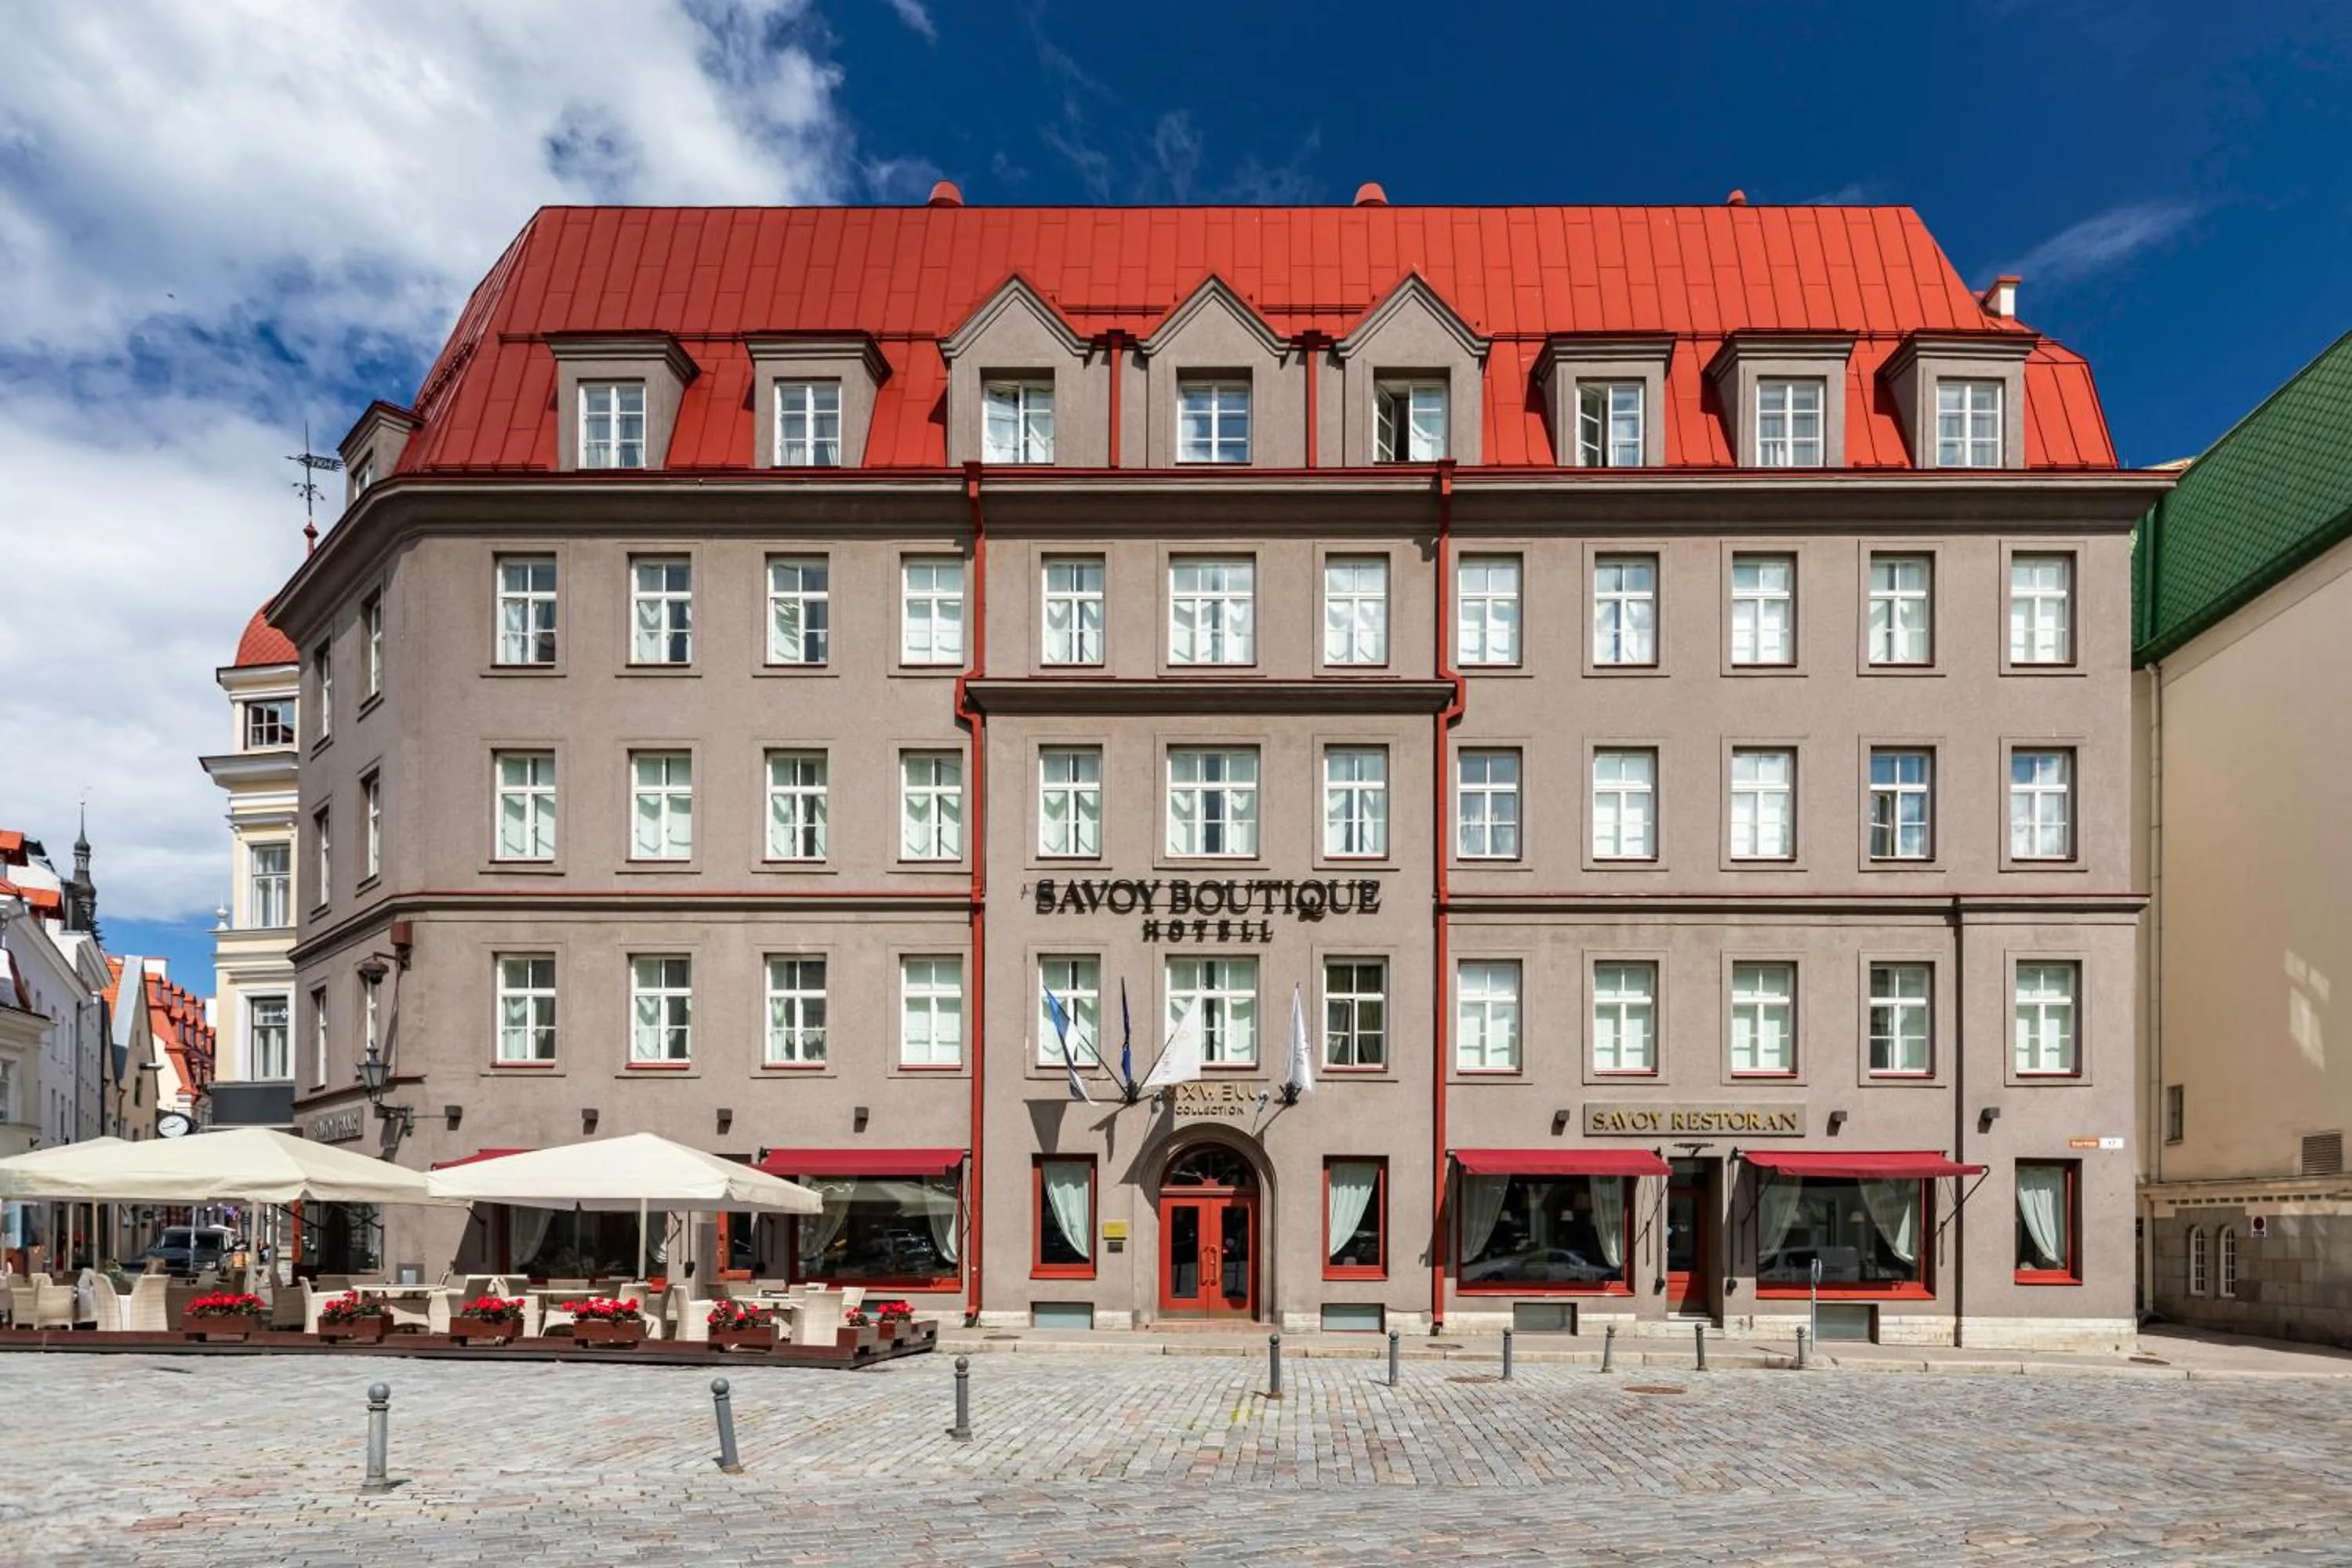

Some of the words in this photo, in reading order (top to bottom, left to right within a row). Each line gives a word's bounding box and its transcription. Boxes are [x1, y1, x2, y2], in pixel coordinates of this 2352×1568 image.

[1036, 879, 1162, 915] SAVOY
[1168, 879, 1382, 922] BOUTIQUE
[1142, 919, 1273, 942] HOTELL
[1176, 1105, 1245, 1116] COLLECTION
[1592, 1110, 1663, 1131] SAVOY
[1671, 1110, 1797, 1131] RESTORAN
